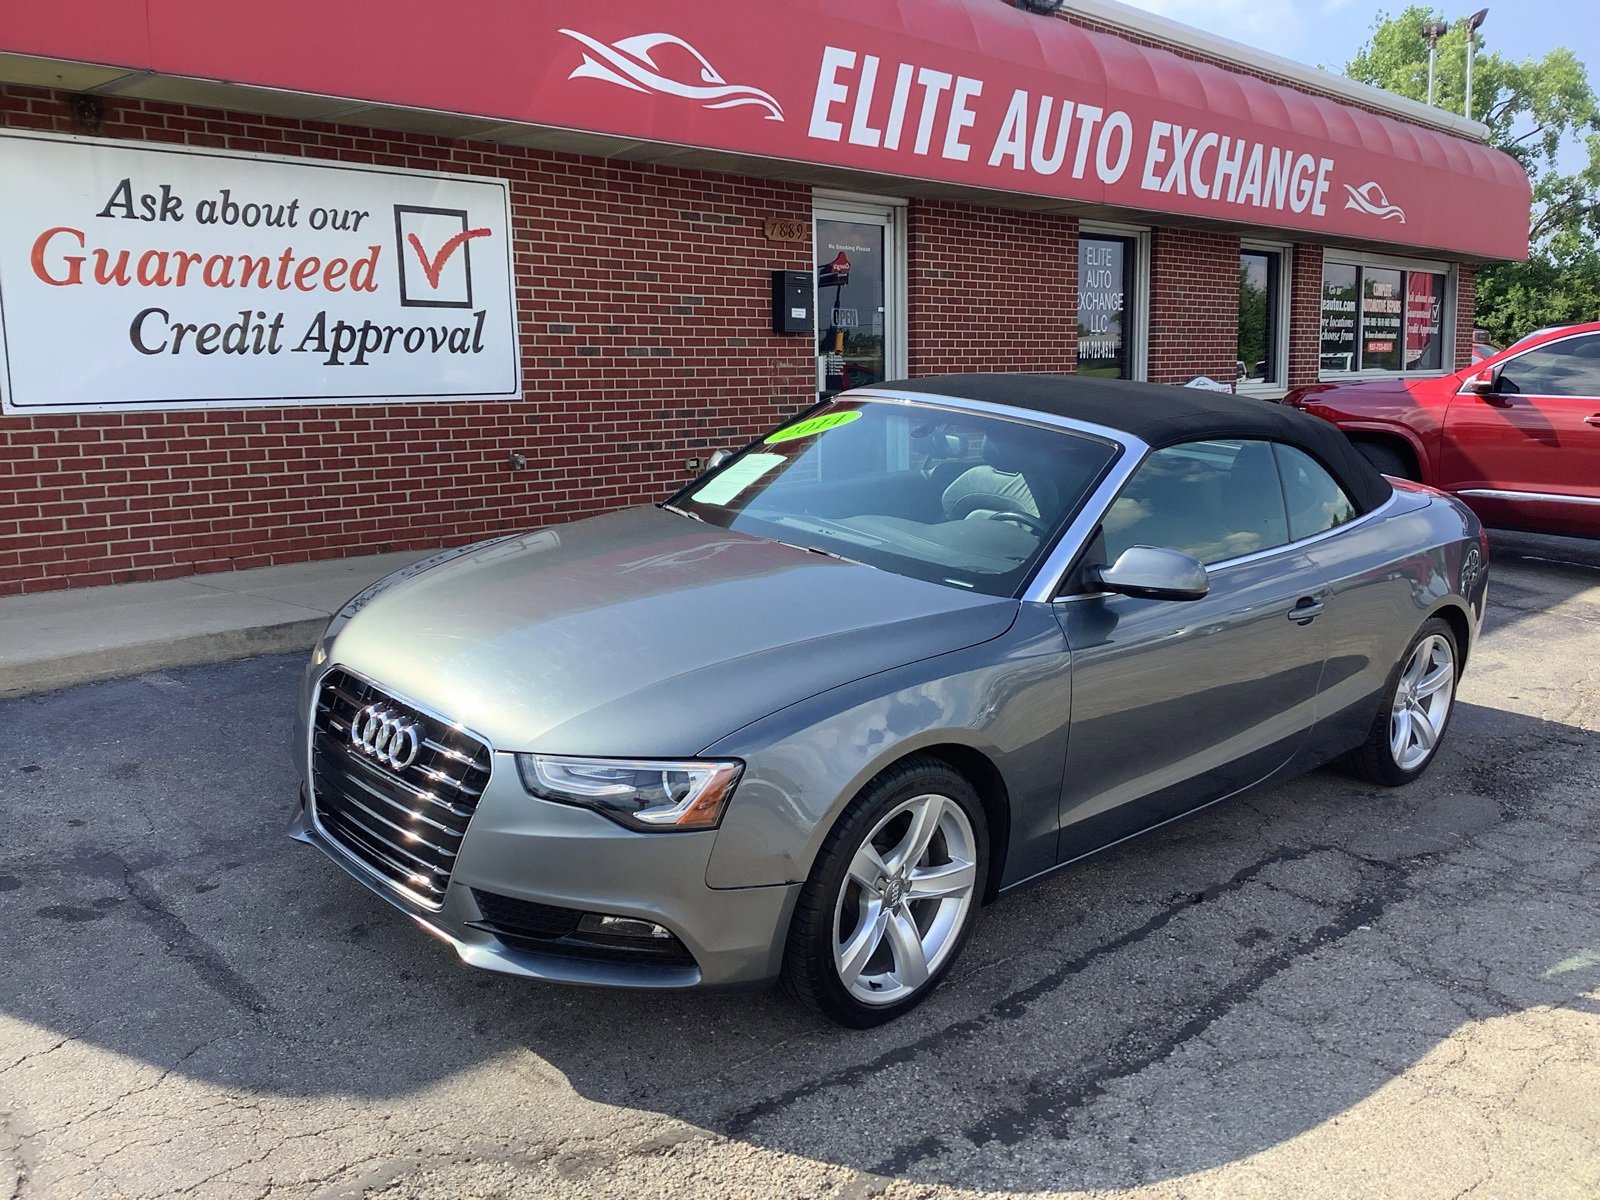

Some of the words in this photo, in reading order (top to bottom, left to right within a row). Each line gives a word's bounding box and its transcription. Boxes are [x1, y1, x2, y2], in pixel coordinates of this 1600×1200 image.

[808, 46, 983, 161] ELITE
[988, 89, 1133, 184] AUTO
[1141, 120, 1334, 216] EXCHANGE
[96, 178, 184, 222] Ask
[195, 189, 299, 228] about
[308, 207, 369, 232] our
[770, 222, 804, 240] 7889
[31, 226, 382, 292] Guaranteed
[1086, 247, 1112, 266] ELITE
[1086, 270, 1111, 288] AUTO
[834, 310, 856, 325] OPEN
[1090, 314, 1108, 333] LLC
[1330, 316, 1353, 327] locations
[129, 307, 284, 355] Credit
[291, 310, 486, 366] Approval
[1340, 330, 1353, 343] from
